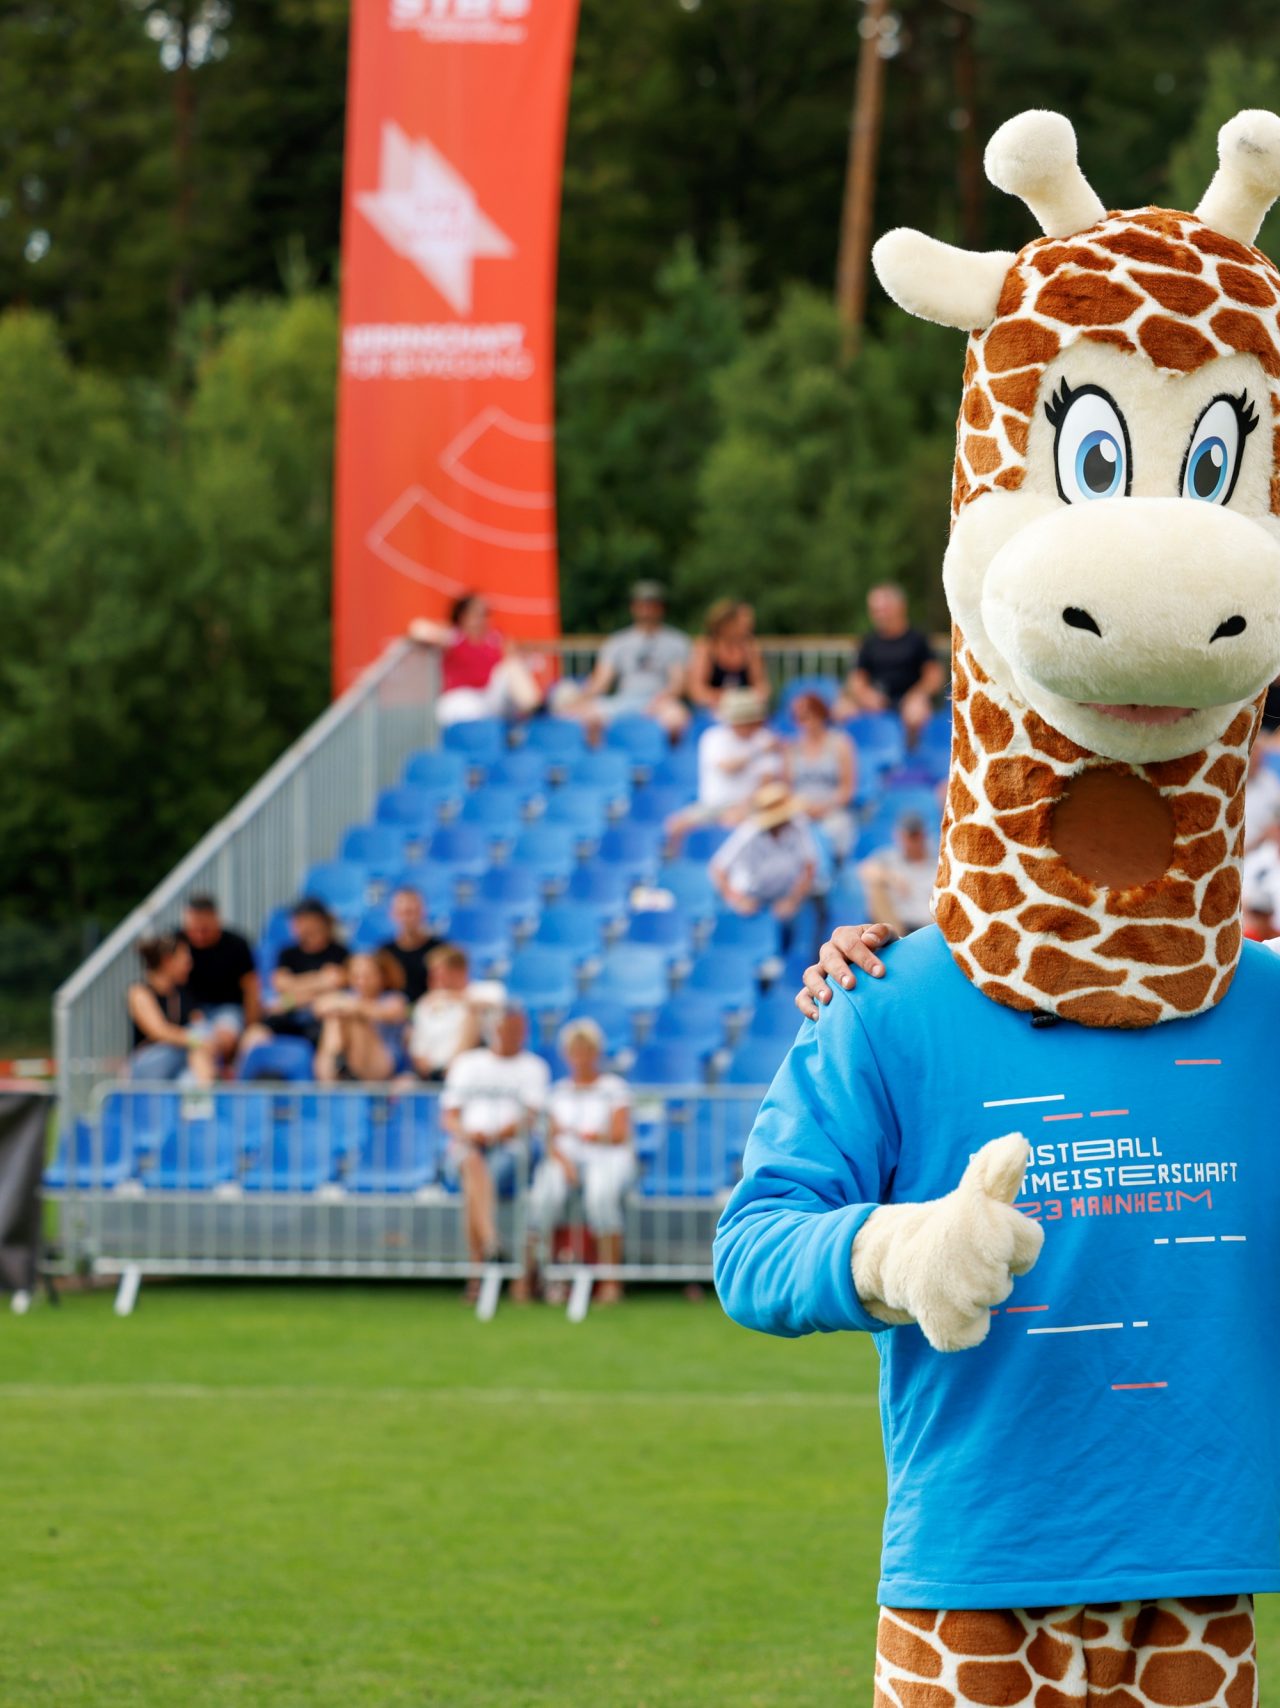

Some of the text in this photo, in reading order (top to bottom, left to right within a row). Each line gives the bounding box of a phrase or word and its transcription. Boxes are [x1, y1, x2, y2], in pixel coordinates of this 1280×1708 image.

[1021, 1162, 1238, 1195] TMEISTERSCHAFT
[1010, 1189, 1213, 1221] 23 MANNHEIM
